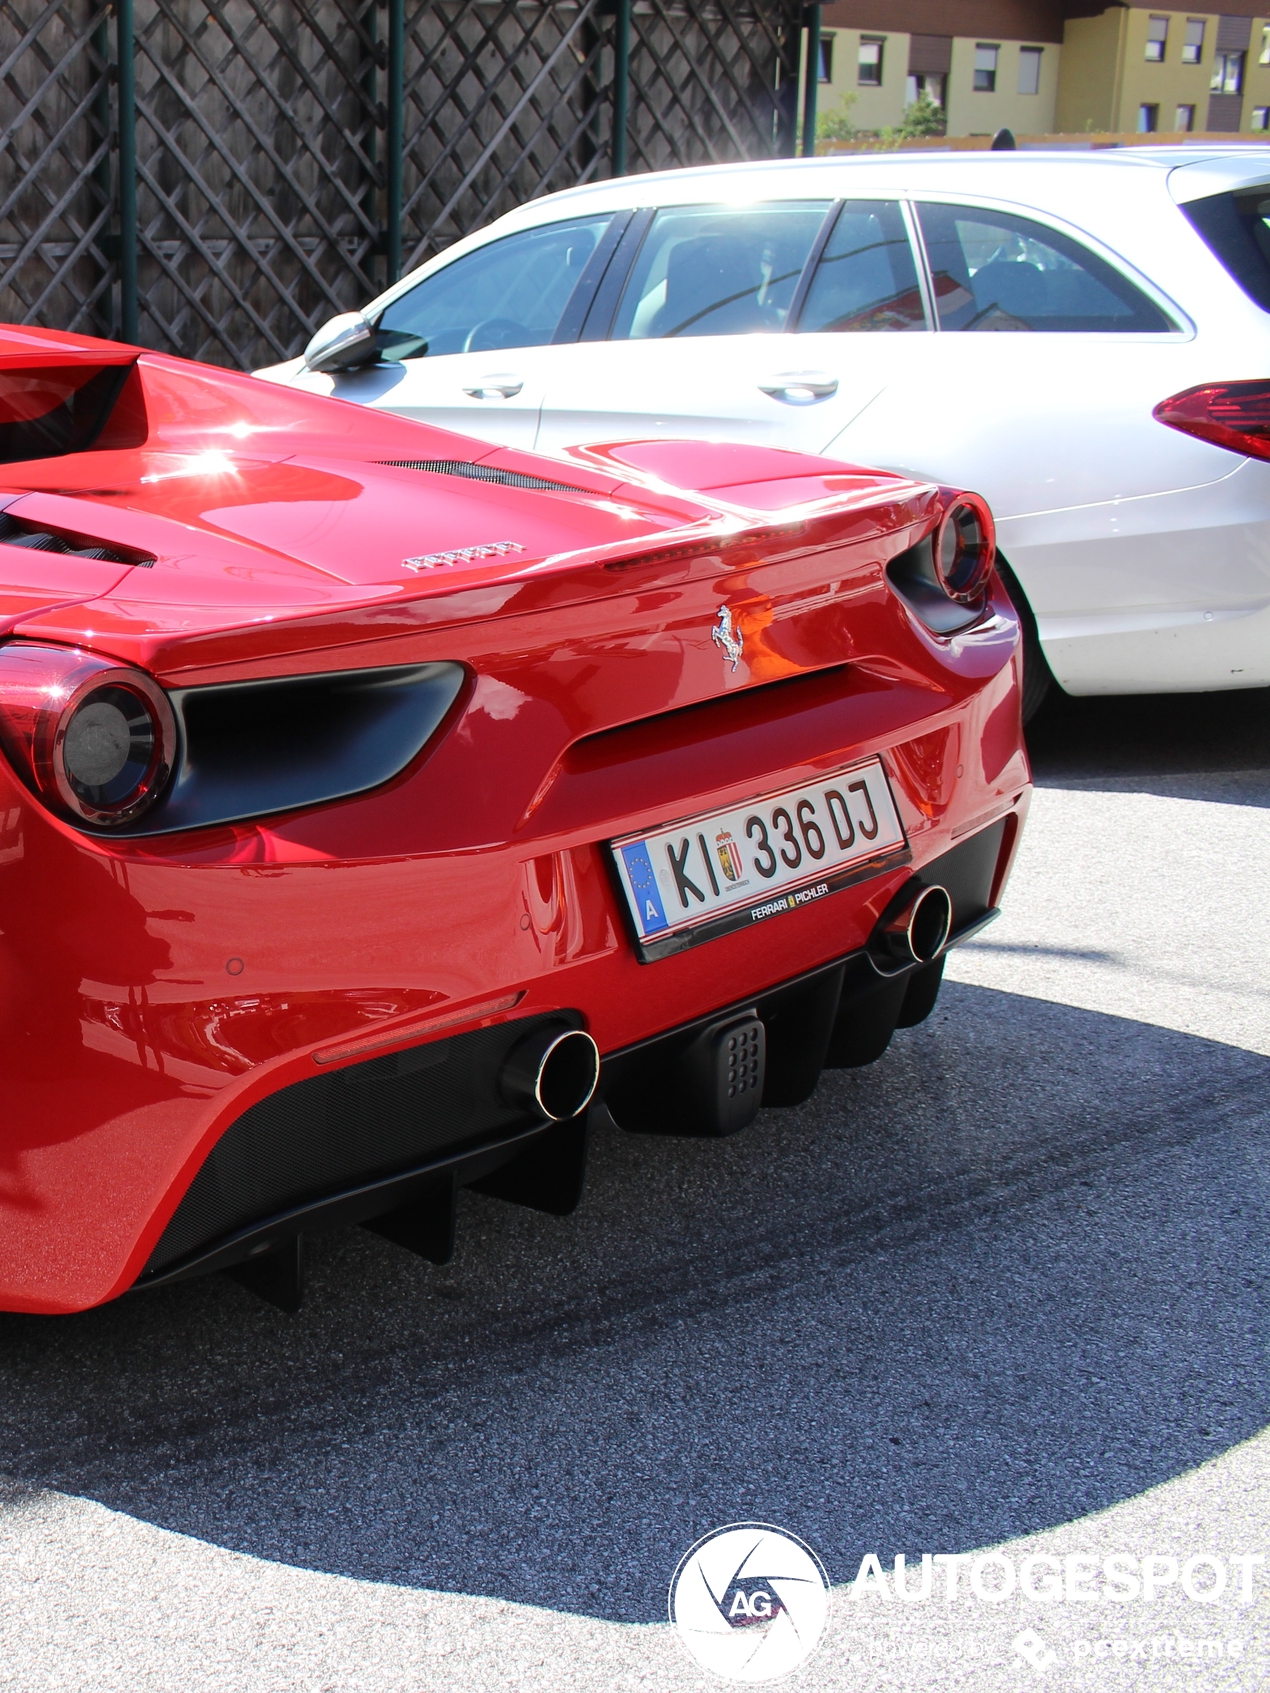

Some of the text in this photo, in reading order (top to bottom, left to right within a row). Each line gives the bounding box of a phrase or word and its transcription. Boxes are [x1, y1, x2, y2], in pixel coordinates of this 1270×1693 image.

[667, 780, 879, 909] KI 336 DJ
[645, 899, 659, 922] A
[751, 883, 829, 920] FERRARI PICHLER
